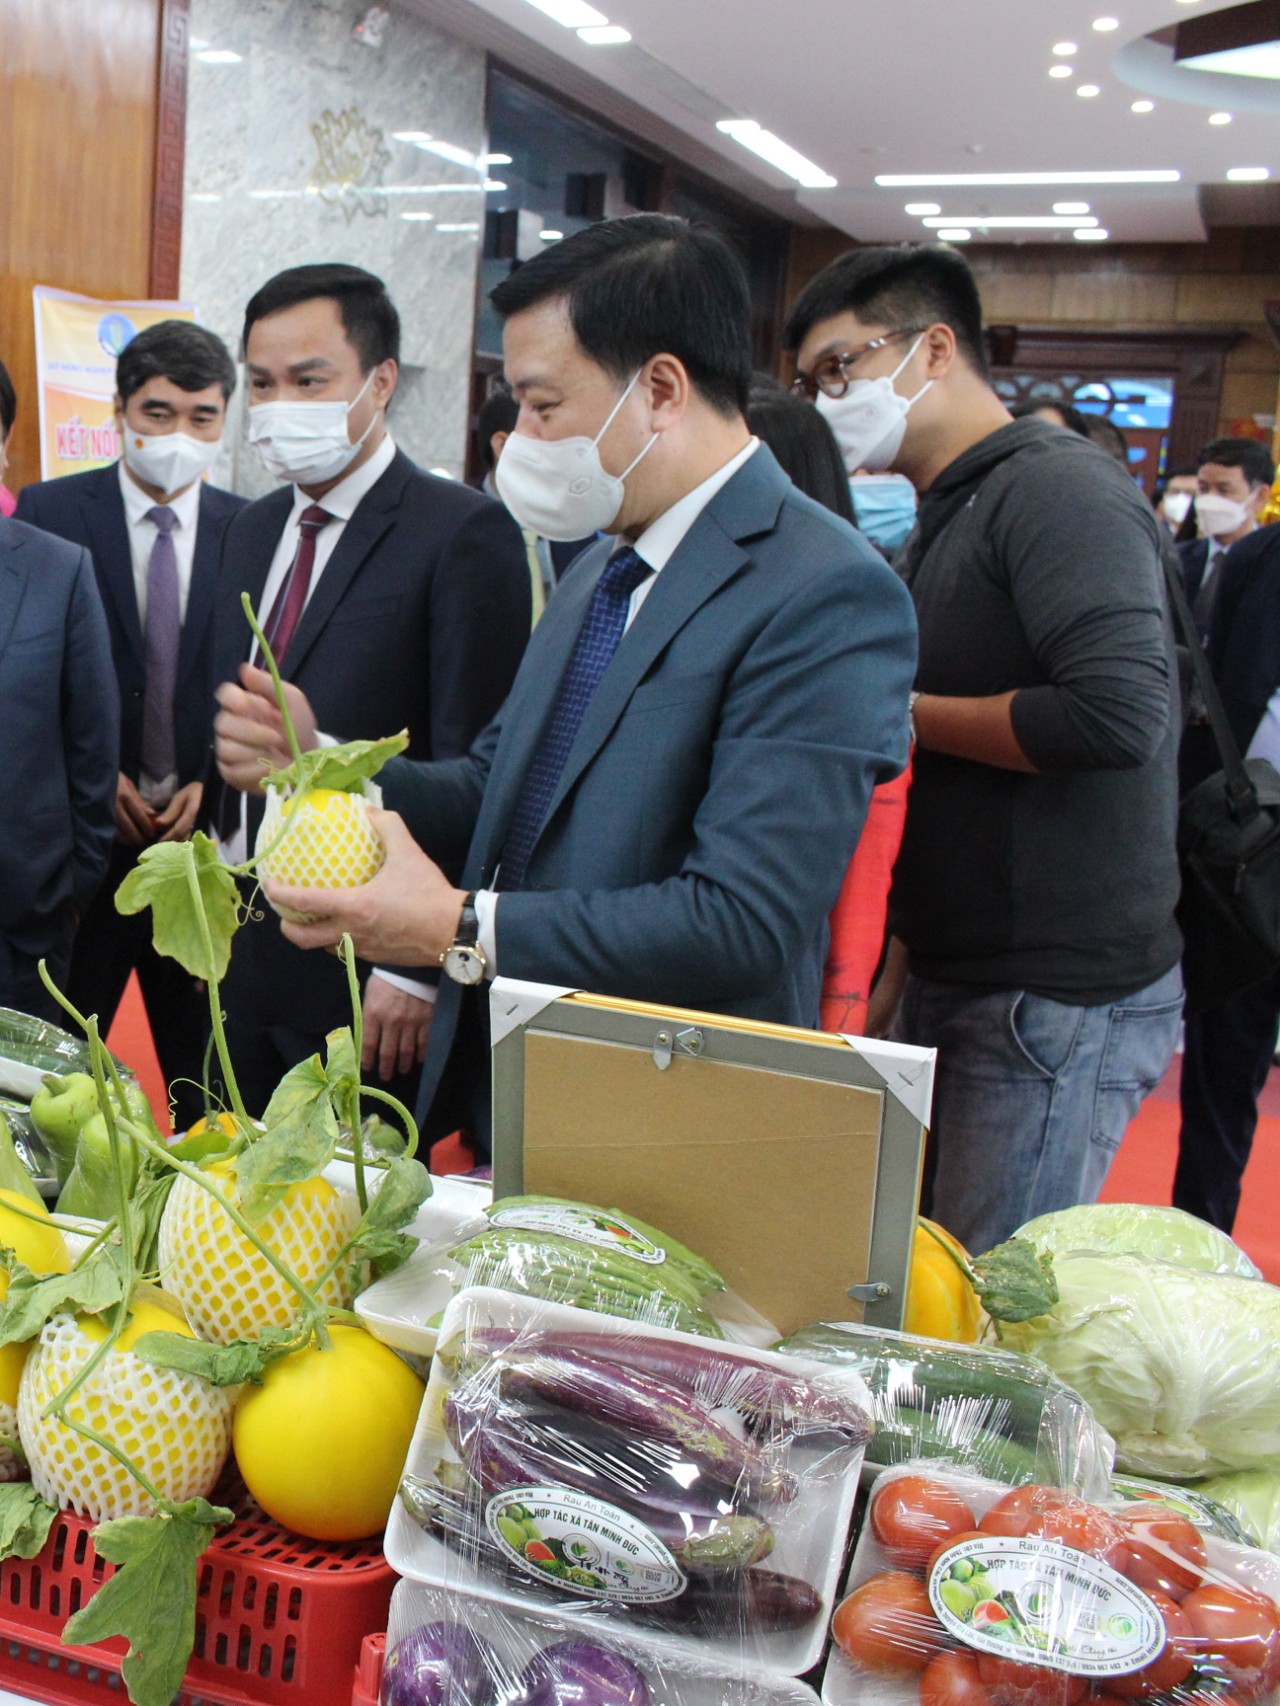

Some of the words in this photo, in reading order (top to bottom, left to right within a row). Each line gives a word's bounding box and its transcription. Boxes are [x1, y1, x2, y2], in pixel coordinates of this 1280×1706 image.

[56, 416, 87, 458] KẾT
[90, 417, 120, 458] NỐI
[563, 1493, 582, 1506] Rau
[584, 1499, 598, 1511] An
[599, 1503, 621, 1521] Toàn
[534, 1507, 551, 1520] HỢP
[553, 1510, 568, 1522] TÁC
[570, 1513, 581, 1526] XÃ
[583, 1518, 600, 1533] TÂN
[600, 1526, 622, 1545] MINH
[622, 1539, 640, 1556] ĐỨC
[1019, 1541, 1040, 1552] Rau
[1061, 1548, 1086, 1565] Toàn
[987, 1558, 1006, 1571] HỢP
[1065, 1571, 1092, 1590] MINH
[1092, 1582, 1112, 1602] ĐỨC
